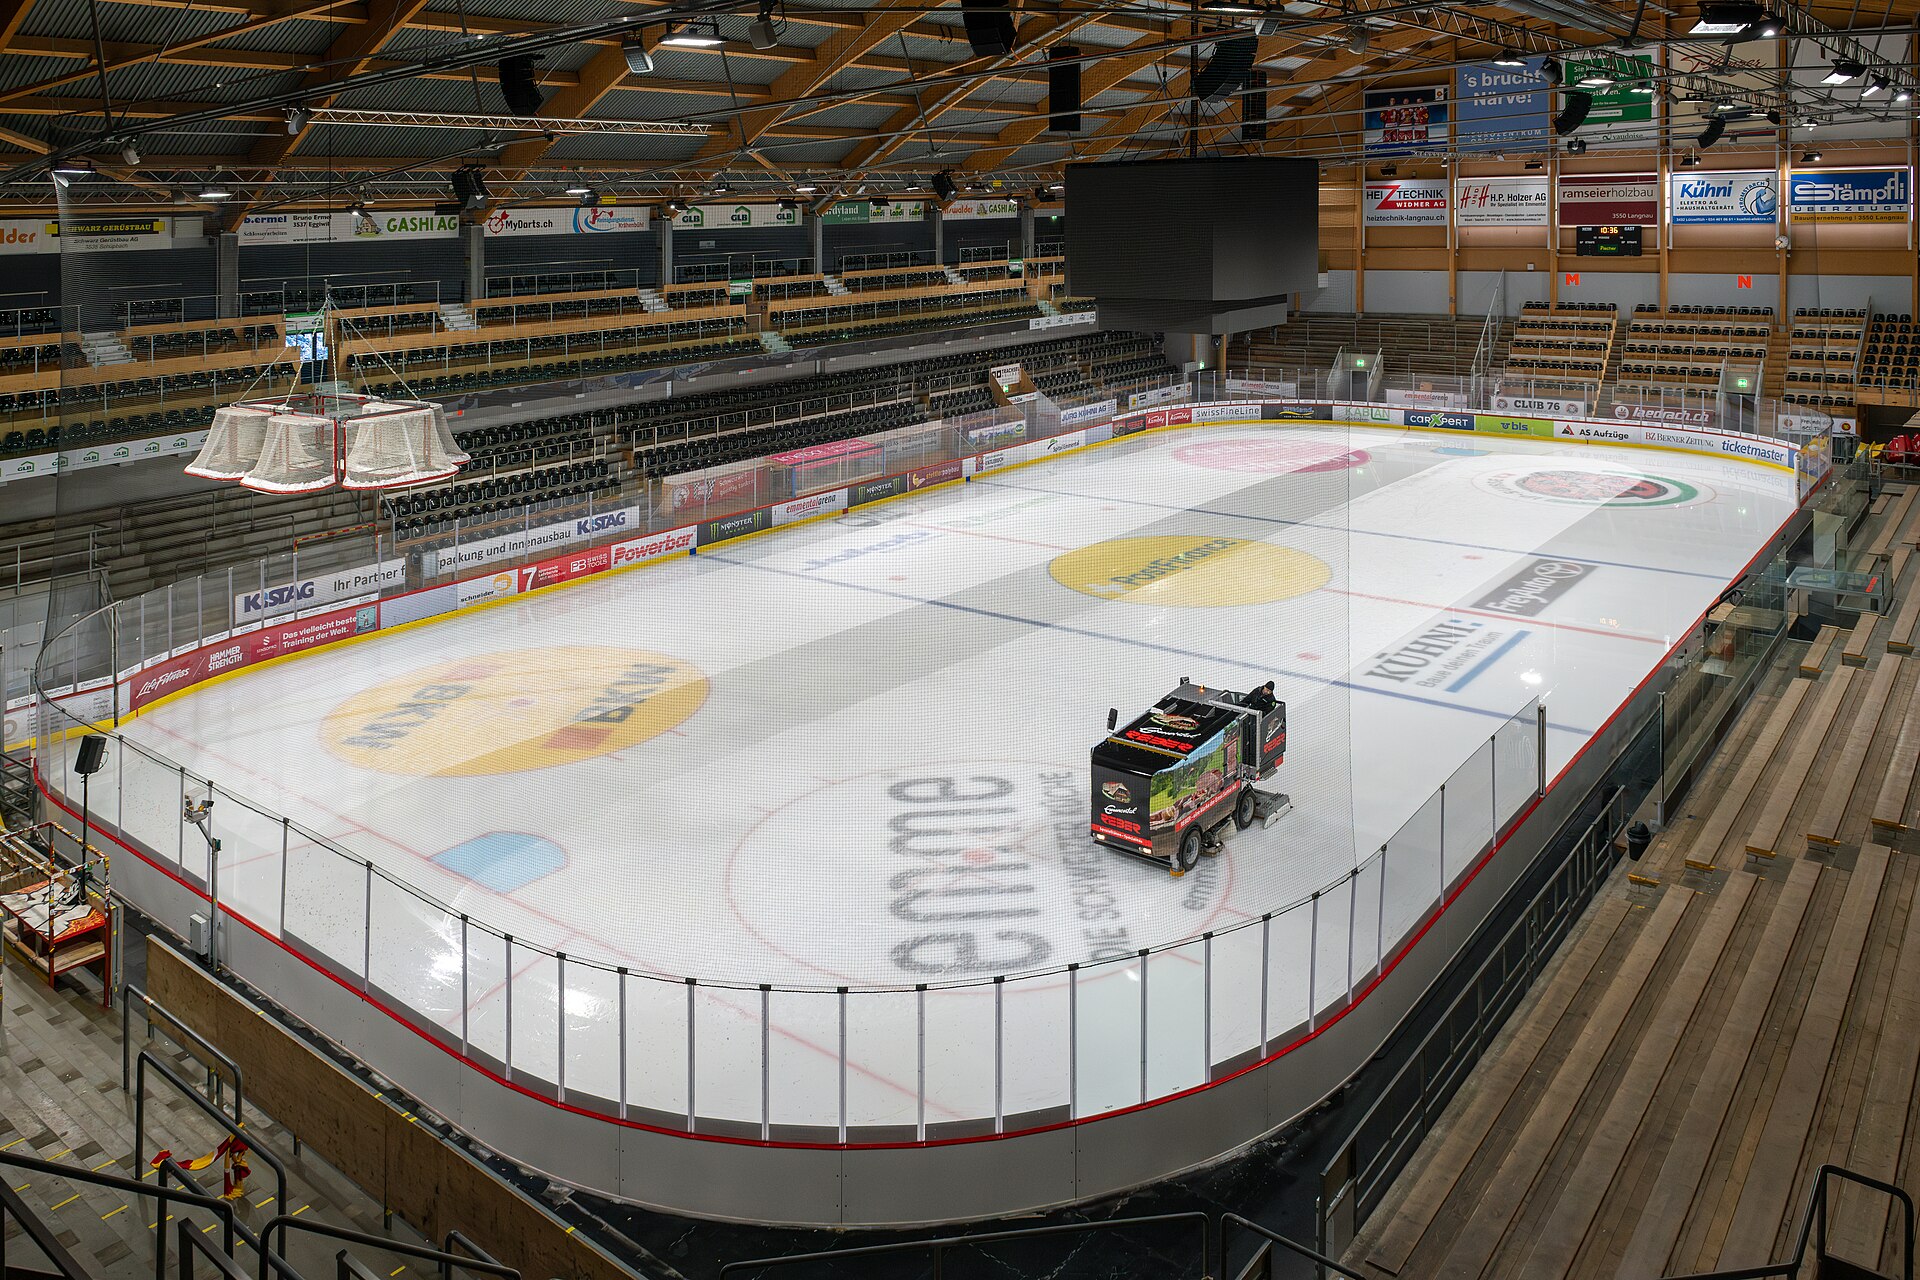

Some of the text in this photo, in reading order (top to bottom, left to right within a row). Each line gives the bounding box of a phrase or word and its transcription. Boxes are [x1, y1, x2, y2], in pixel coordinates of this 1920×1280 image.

[1481, 69, 1542, 87] brucht
[1562, 187, 1654, 198] ramseierholzbau
[1680, 180, 1733, 199] Kühni
[1794, 172, 1904, 204] Stämpfli
[1490, 193, 1547, 202] H.P. Holzer AG
[988, 203, 1018, 214] GASHI AG
[1627, 211, 1654, 220] Langnau
[387, 215, 459, 233] GASHI AG
[681, 214, 701, 223] GLB
[730, 213, 748, 222] GLB
[775, 212, 793, 221] GLB
[1366, 214, 1445, 222] heiztechnik-langnau.ch
[102, 223, 151, 232] GERÜSTBAU
[505, 219, 553, 231] MyDarts.ch
[1600, 226, 1619, 234] 10:36
[1565, 273, 1580, 286] M
[1737, 275, 1752, 289] N
[1098, 405, 1107, 413] AG
[1514, 399, 1560, 411] CLUB 76
[1511, 421, 1529, 431] bls
[1579, 428, 1630, 441] AS Aufzüge
[1645, 431, 1714, 448] BZ BERNER ZEITUNG
[1721, 439, 1785, 462] ticketmaster
[785, 493, 836, 514] emmentalarena
[720, 517, 753, 531] MONSTER
[486, 541, 506, 556] und
[508, 529, 571, 552] Innenausbau
[613, 531, 694, 565] Powerbar
[587, 558, 608, 569] TOOLS
[1111, 537, 1239, 586] PostFinance
[333, 579, 351, 592] Ihr
[354, 567, 398, 588] Partner
[522, 565, 538, 593] 7
[460, 589, 495, 603] schneider
[282, 614, 356, 640] Das vielleicht beste
[282, 625, 350, 649] Training der Welt.
[1469, 630, 1504, 654] Traum
[210, 645, 241, 663] HAMMER
[1364, 623, 1473, 683] KÜHNI
[208, 652, 243, 672] STRENGTH
[1125, 729, 1194, 752] REBER
[1100, 812, 1141, 835] REBER
